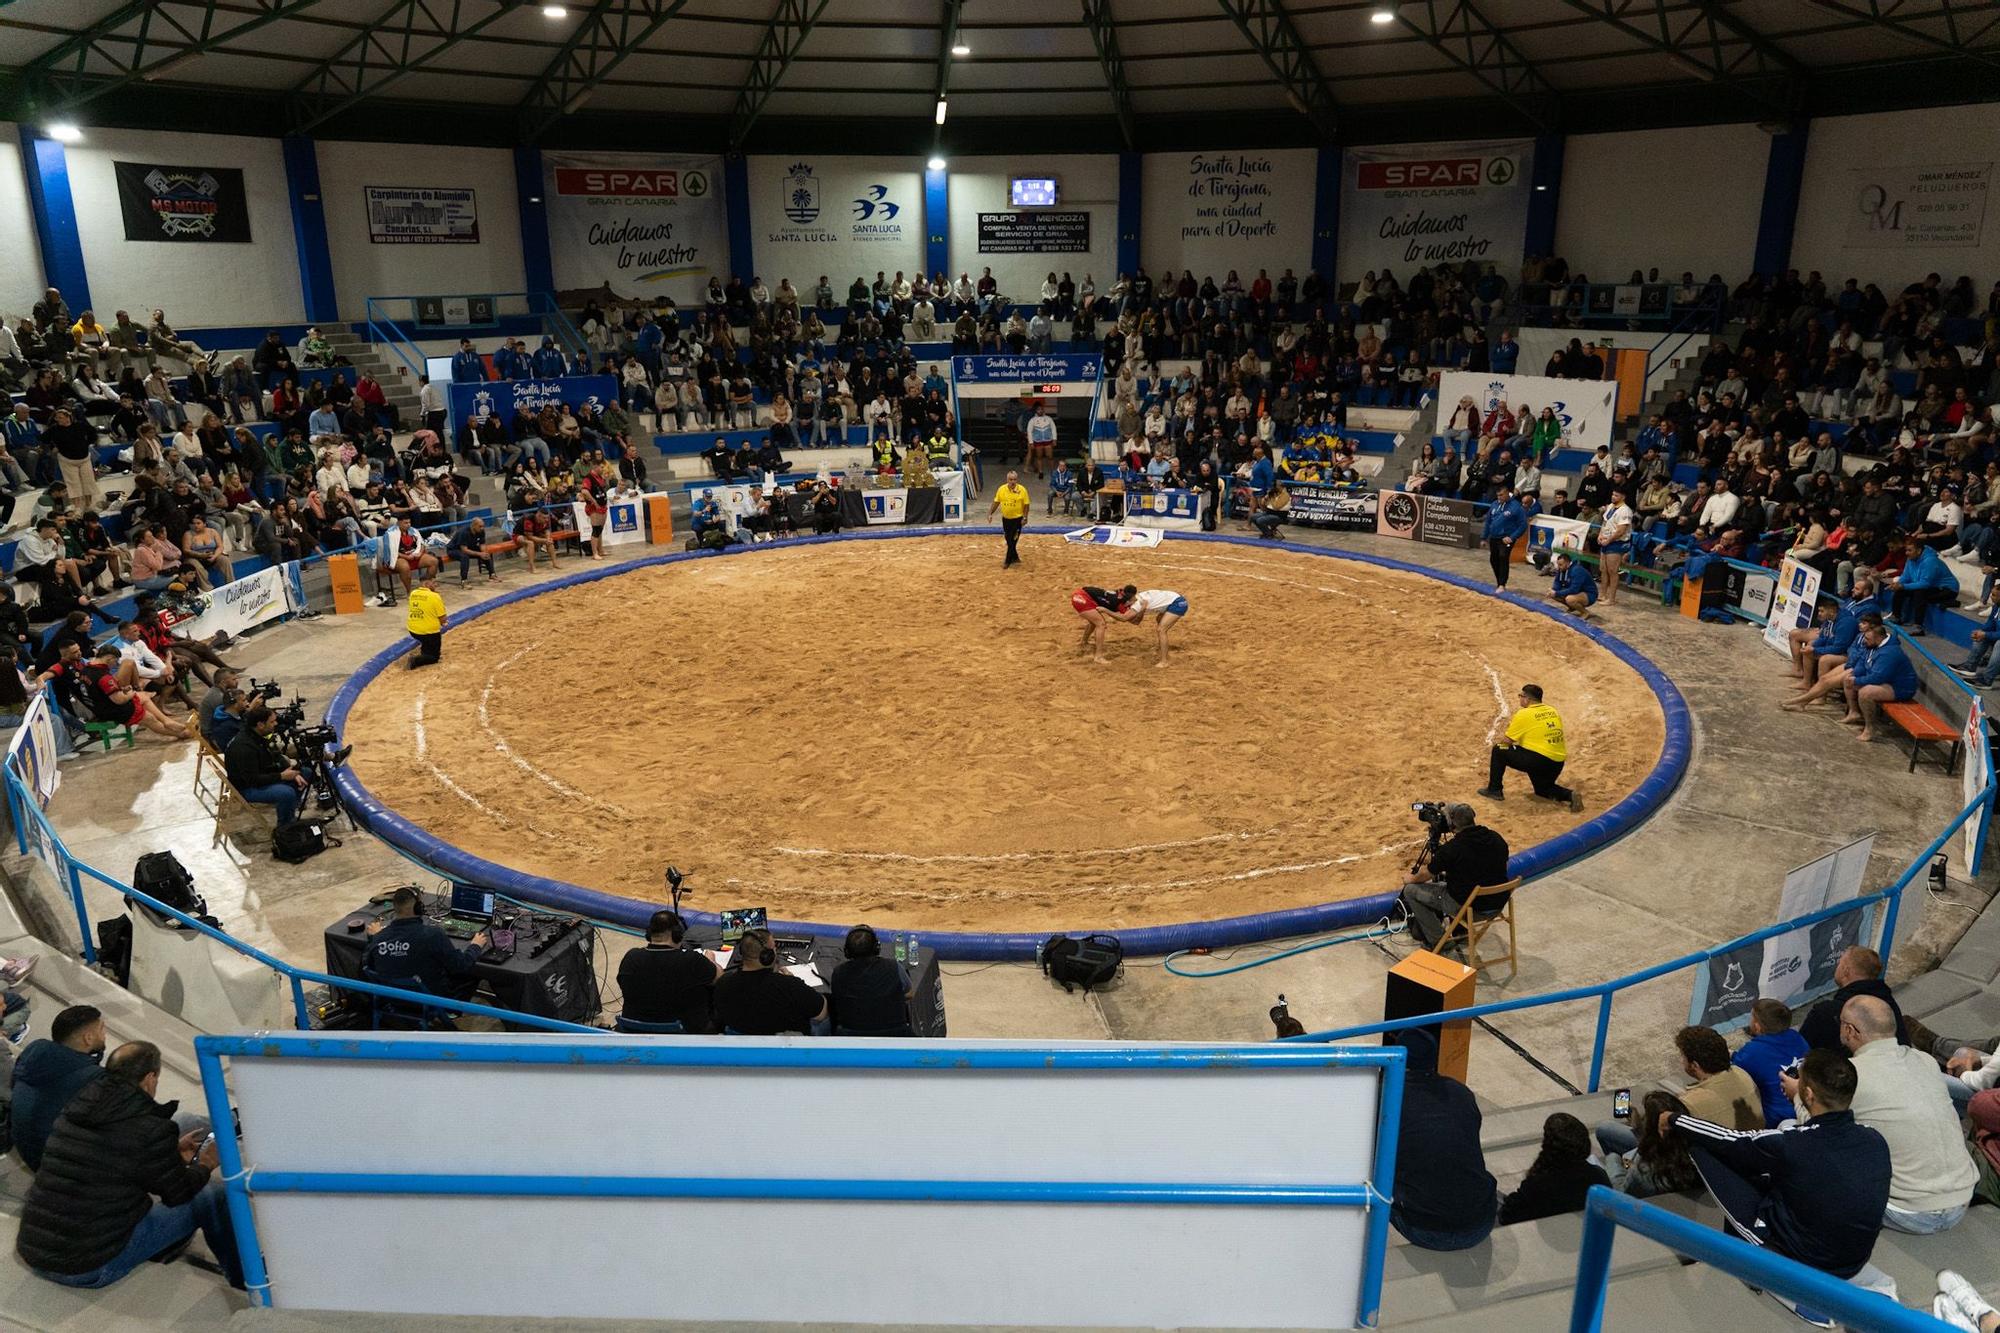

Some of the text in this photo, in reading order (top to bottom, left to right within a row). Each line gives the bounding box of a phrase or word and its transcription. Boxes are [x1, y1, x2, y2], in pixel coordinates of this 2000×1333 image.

[1190, 155, 1233, 174] Santa
[1385, 163, 1478, 184] SPAR
[1919, 173, 1943, 181] OMAR
[585, 174, 676, 192] SPAR
[1910, 182, 1986, 192] PELUQUEROS
[422, 191, 432, 200] de
[434, 191, 470, 201] Aluminio
[1188, 177, 1272, 203] de Tirajana,
[1384, 188, 1477, 199] GRAN CANARIA
[175, 200, 218, 214] MOTOR
[587, 198, 677, 206] GRAN CANARIA
[1197, 202, 1262, 218] una ciudad
[852, 224, 878, 233] SANTA
[1182, 219, 1278, 241] para el Deporte
[1379, 210, 1468, 239] Cuidamos
[588, 218, 673, 246] Cuidamos
[768, 234, 801, 242] SANTA
[1404, 235, 1493, 262] lo nuestro
[617, 244, 698, 269] lo nuestro
[986, 358, 1008, 368] Santa
[1028, 358, 1036, 367] de
[513, 383, 540, 396] Santa
[514, 398, 523, 409] de
[1291, 487, 1309, 496] VENTA
[1310, 488, 1318, 497] DE
[1427, 502, 1450, 512] Calzado
[1296, 511, 1309, 519] EN
[1310, 512, 1334, 521] VENTA
[1426, 511, 1469, 523] Complementos
[240, 600, 248, 615] lo
